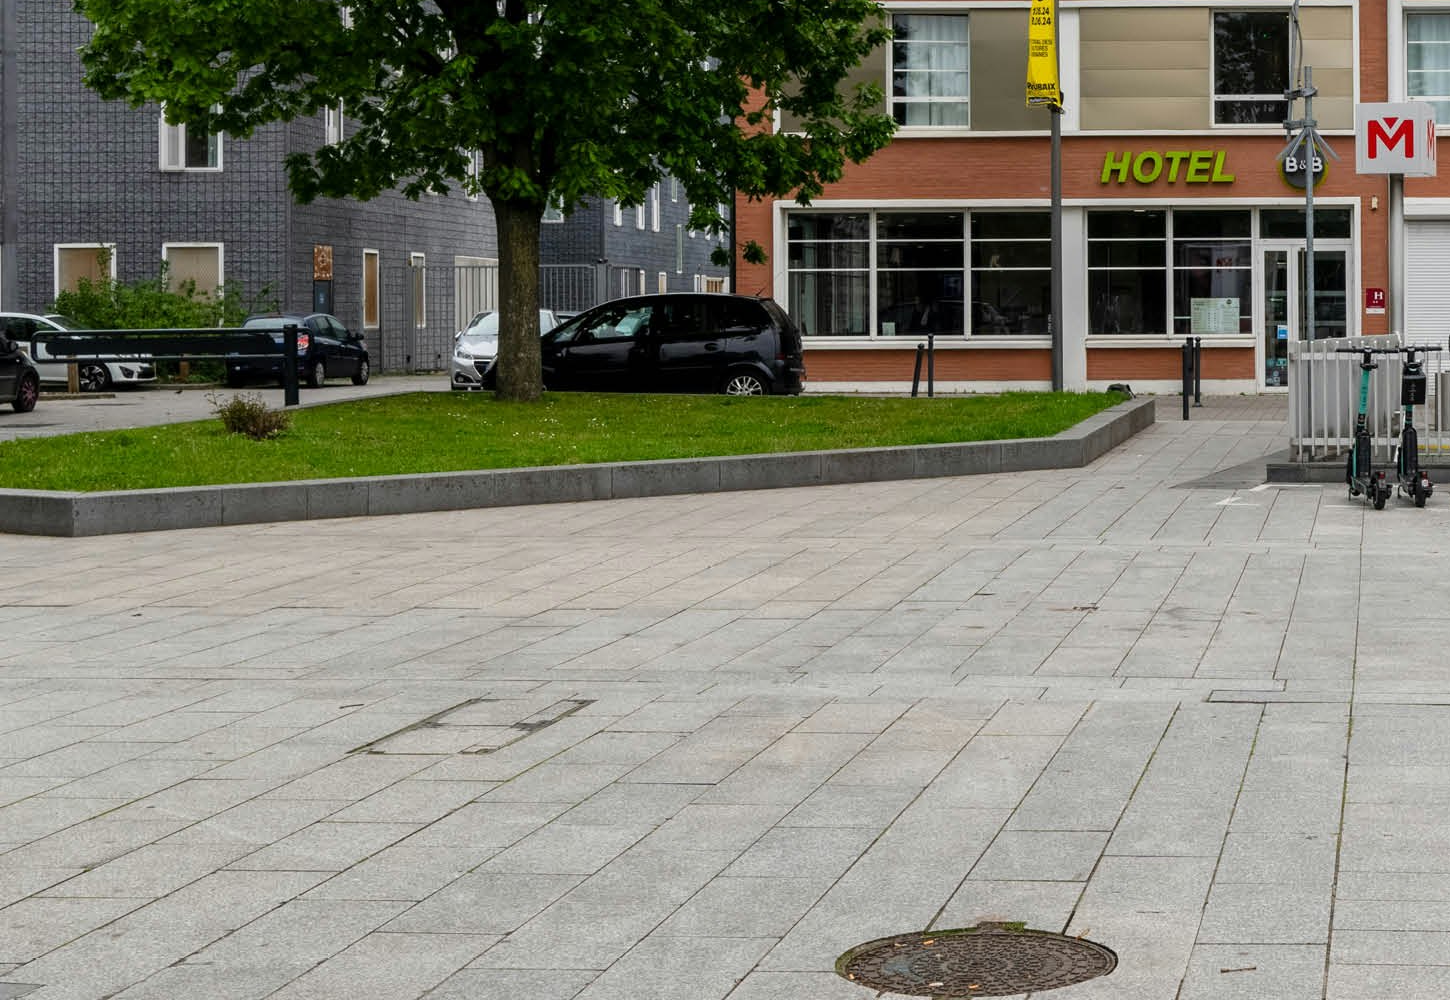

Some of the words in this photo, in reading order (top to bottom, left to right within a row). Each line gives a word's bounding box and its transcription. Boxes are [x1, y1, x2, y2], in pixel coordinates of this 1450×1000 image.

[1368, 117, 1414, 159] M
[1101, 151, 1236, 184] HOTEL
[1285, 156, 1323, 172] B&B
[1374, 291, 1383, 300] H
